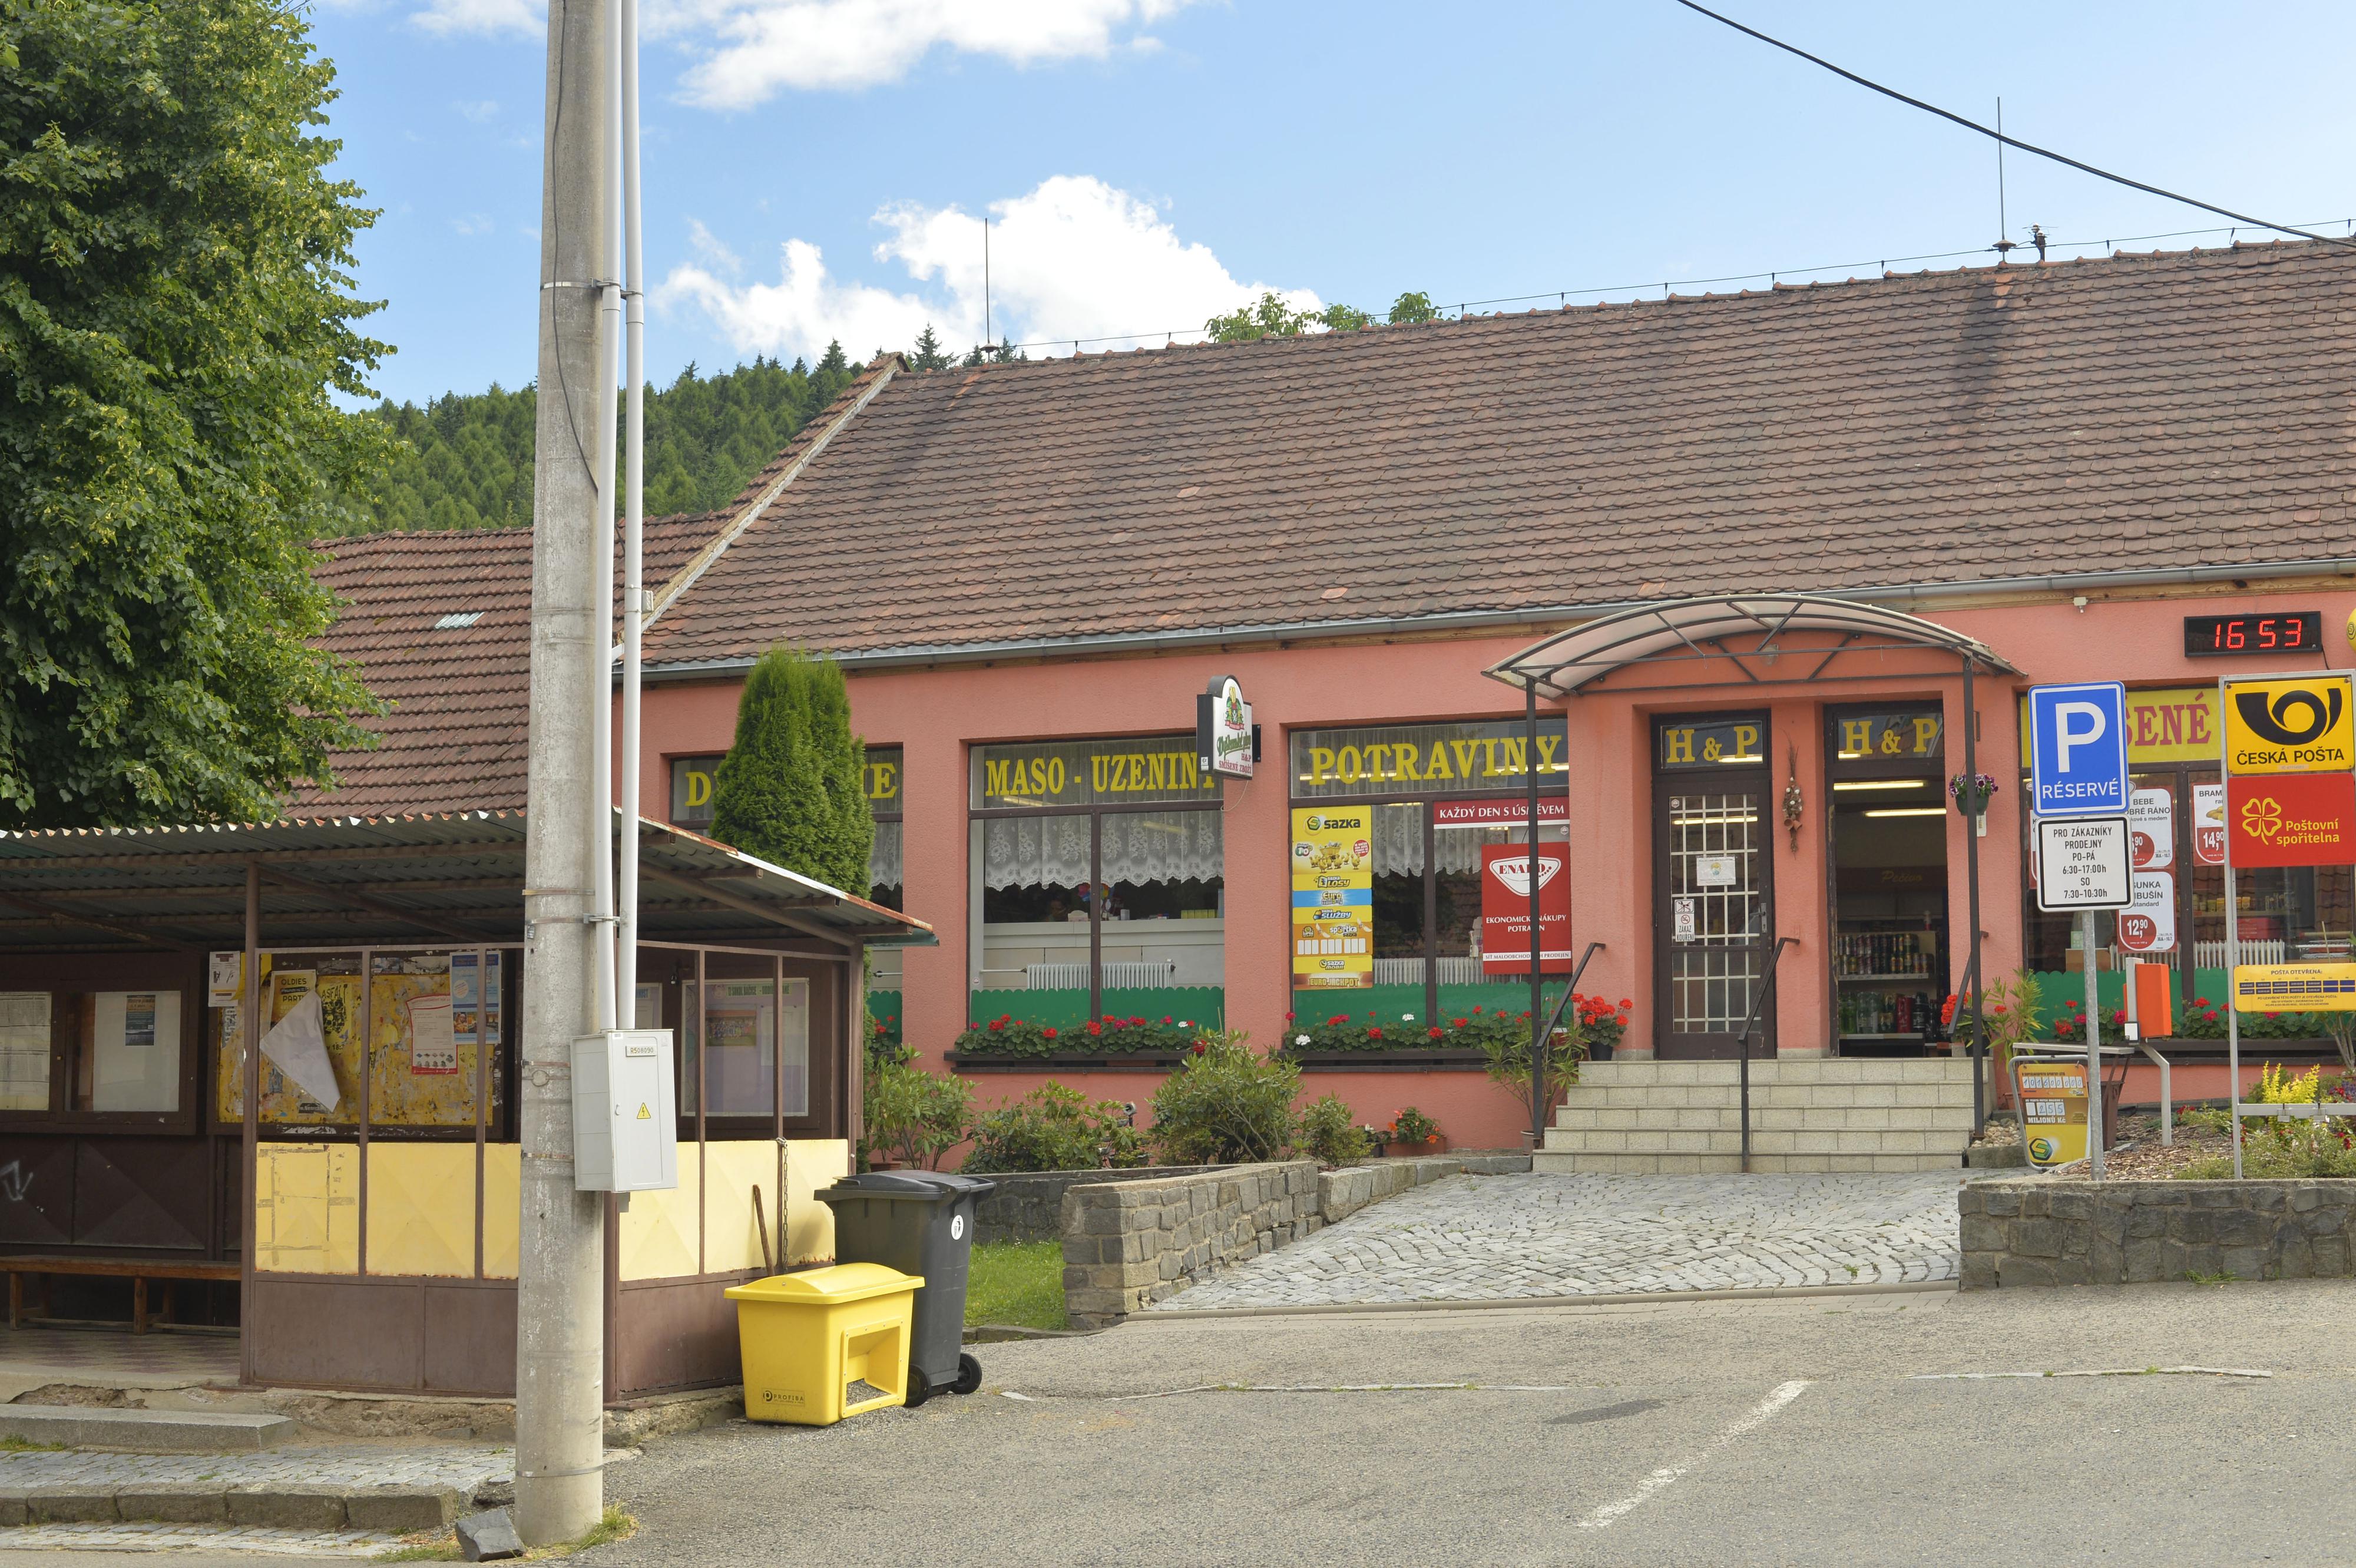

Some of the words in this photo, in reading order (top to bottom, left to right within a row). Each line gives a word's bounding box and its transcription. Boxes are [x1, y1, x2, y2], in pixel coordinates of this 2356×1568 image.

[2215, 621, 2245, 649] 16
[2259, 619, 2302, 647] 53
[1843, 721, 1872, 755] H
[1881, 729, 1901, 754] &
[1912, 718, 1937, 752] P
[2056, 702, 2106, 773] P
[1666, 729, 1695, 763] H
[1703, 737, 1722, 761] &
[1734, 726, 1758, 758] P
[1241, 753, 1251, 762] H&P
[1309, 735, 1561, 786] POTRAVINY
[2236, 747, 2288, 765] ČESKÁ
[2294, 746, 2345, 762] POŠTA
[1219, 760, 1239, 771] SMÍŠENÉ
[1239, 764, 1252, 774] ZBOŽÍ
[985, 757, 1065, 796] MASO
[2042, 778, 2119, 799] RÉSERVÉ
[1440, 806, 1475, 819] KAŽDÝ
[1478, 808, 1500, 817] DEN
[1504, 807, 1509, 816] S
[1513, 803, 1564, 816] ÚSĚVEM
[2053, 829, 2067, 838] PRO
[2072, 825, 2112, 837] ZÁKAZNÍKY
[2286, 818, 2339, 831] Poštovní
[2065, 839, 2102, 849] PRODEJNY
[2132, 836, 2143, 855] ,90
[2276, 832, 2340, 847] spořitelna
[2073, 850, 2095, 861] PO-PÁ
[2063, 864, 2106, 874] 6:30-17:00h
[2064, 889, 2107, 898] 7:30-10:30h
[1486, 915, 1530, 924] EKONOMICK
[1679, 924, 1692, 933] ZÁKAZ
[2127, 919, 2148, 938] 12,90
[1676, 933, 1695, 941] KOUŘENÍ
[2039, 1104, 2063, 1113] 255
